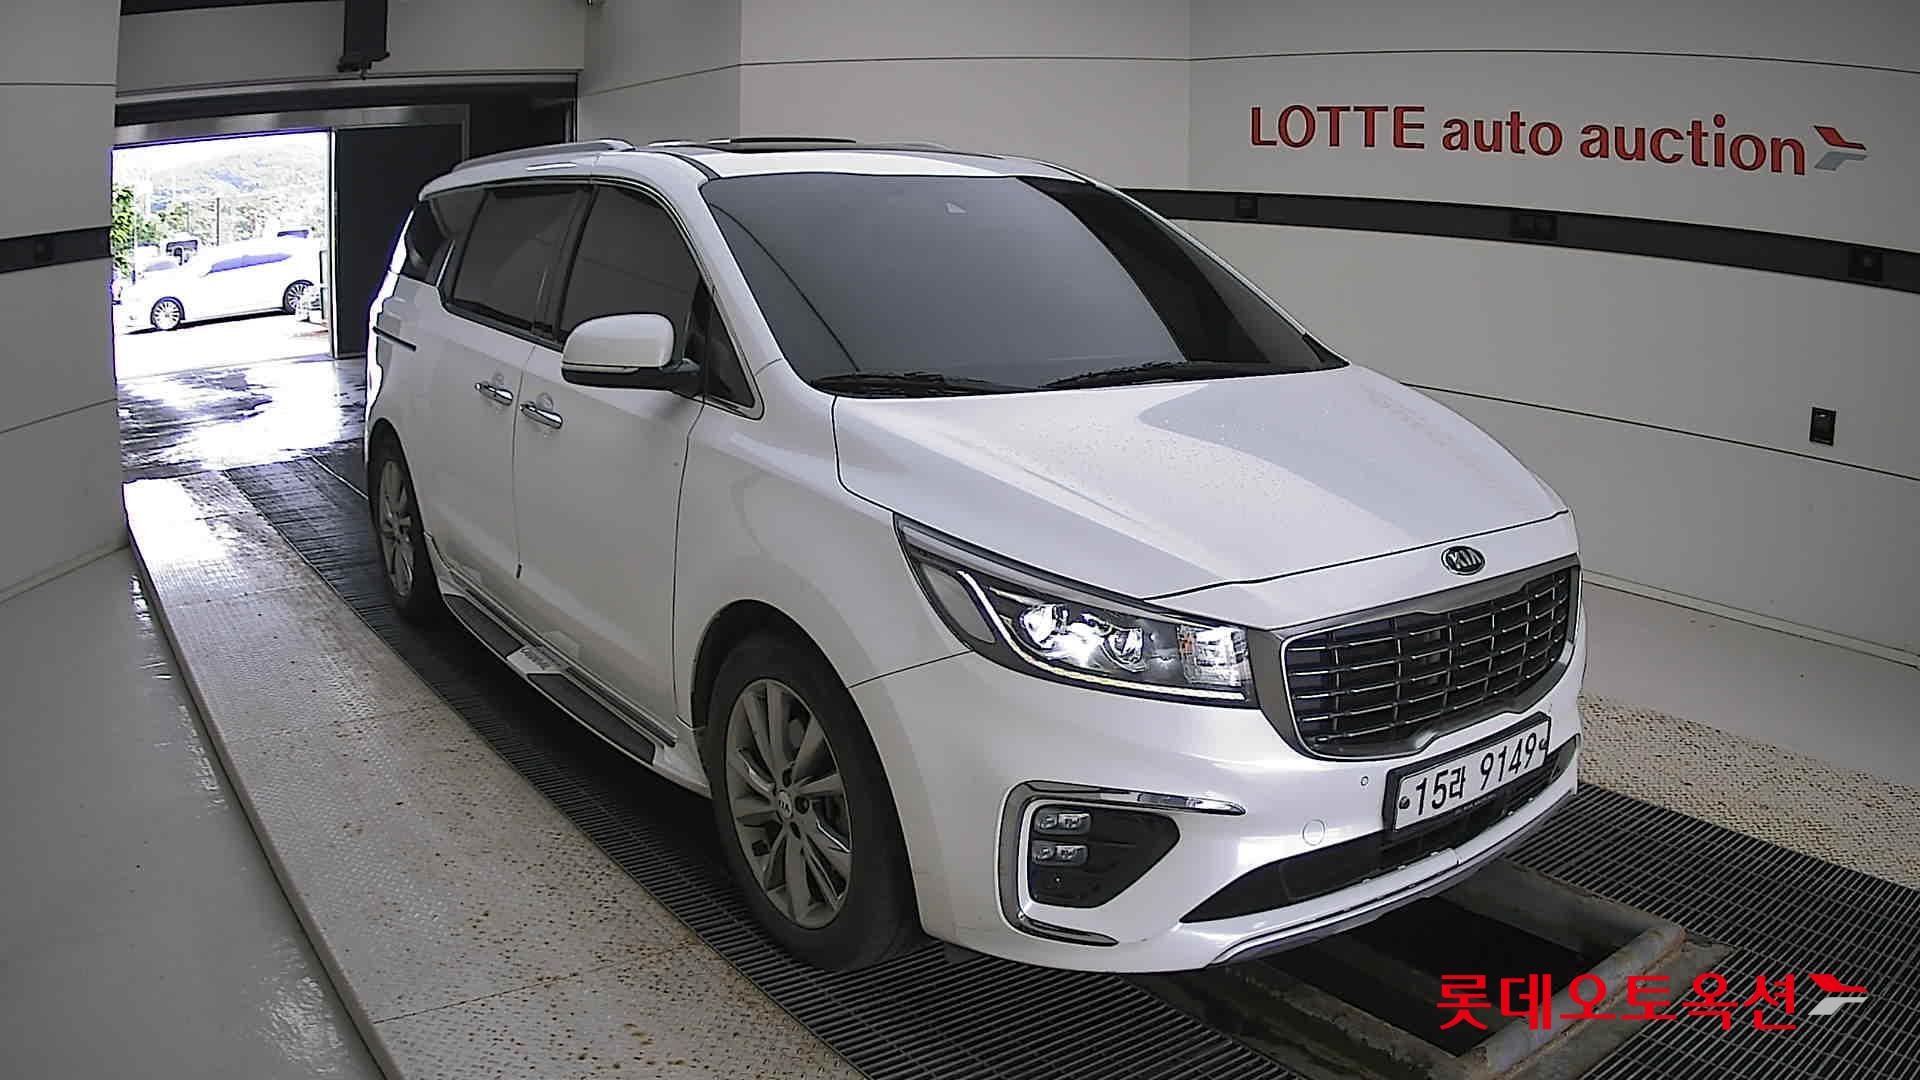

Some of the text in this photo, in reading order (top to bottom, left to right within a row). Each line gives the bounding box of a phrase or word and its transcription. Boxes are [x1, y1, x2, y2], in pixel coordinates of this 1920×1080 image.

[1250, 105, 1806, 175] LOTTE auto auction
[1446, 548, 1482, 570] KIA
[1415, 732, 1537, 816] 15라 9149
